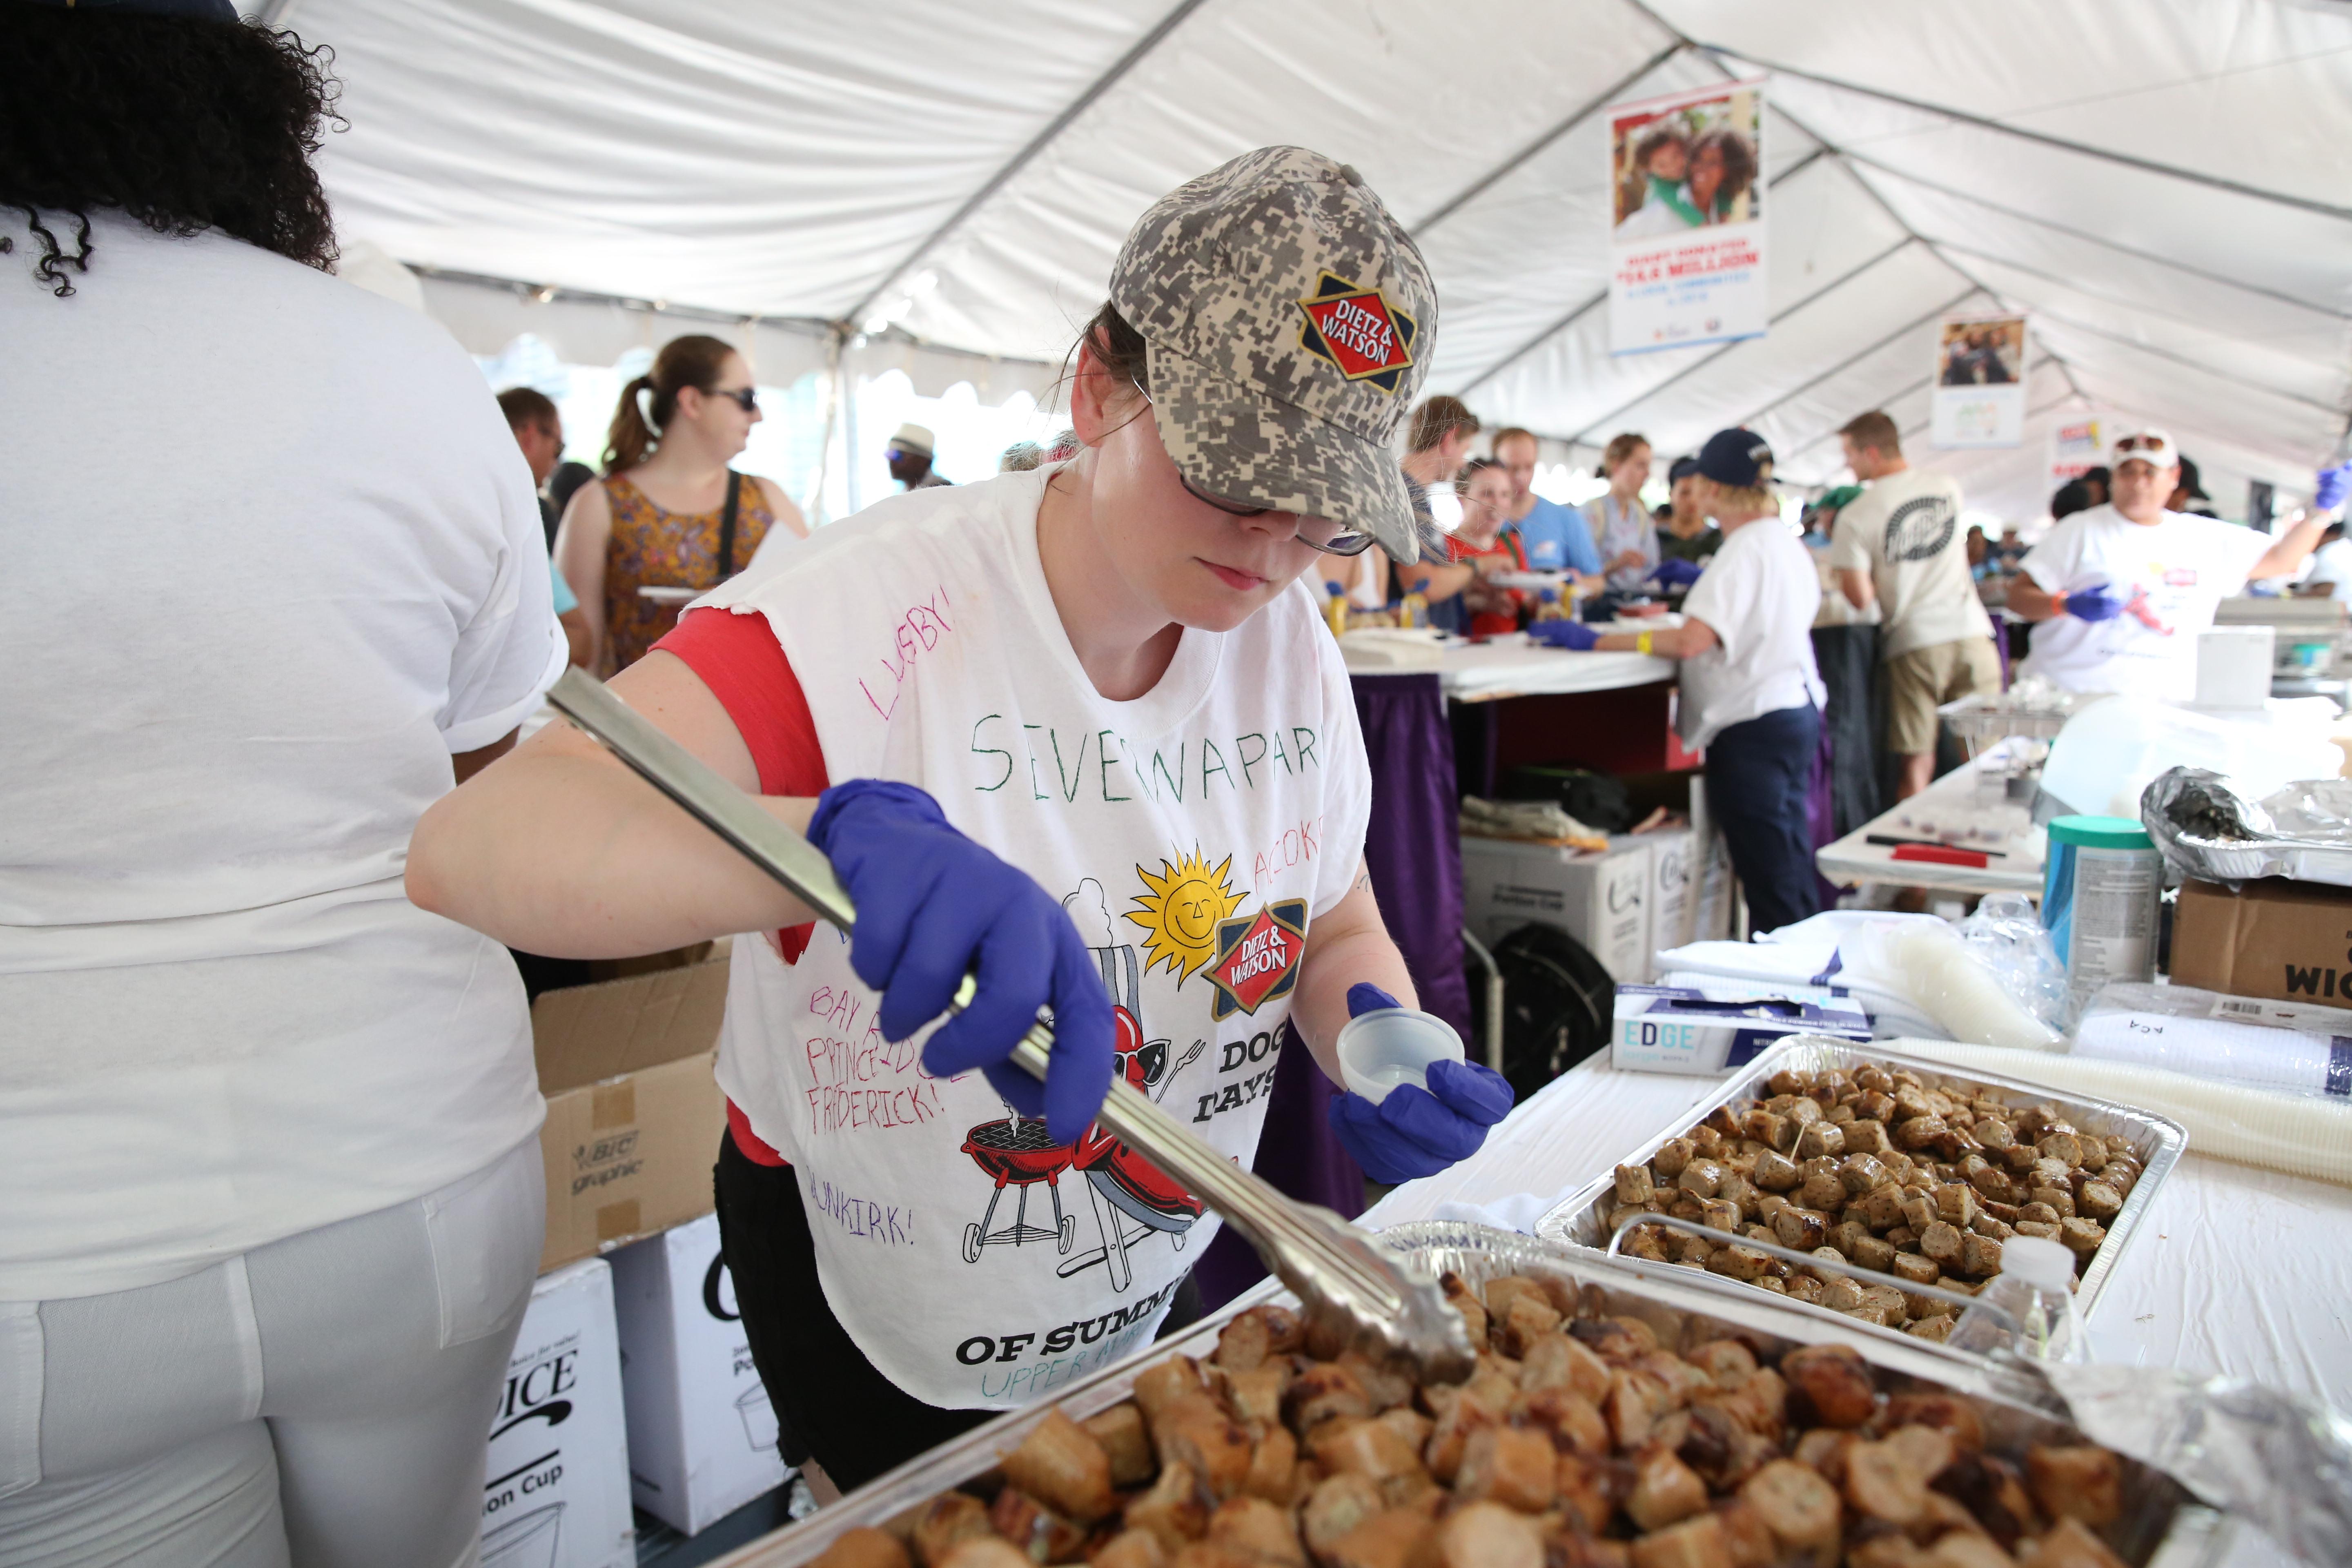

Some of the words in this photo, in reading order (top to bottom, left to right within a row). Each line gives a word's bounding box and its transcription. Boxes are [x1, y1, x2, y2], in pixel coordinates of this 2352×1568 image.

[1322, 314, 1390, 366] WATSON
[1335, 300, 1383, 339] DIETZ
[1380, 325, 1392, 347] &
[1241, 929, 1269, 962] DIETZ
[1270, 925, 1287, 947] &
[1231, 947, 1286, 987] WATSON
[810, 986, 861, 1032] BAY
[1624, 1021, 1695, 1049] EDGE
[806, 1038, 879, 1085] PRINCE
[956, 1333, 1036, 1365] OF
[496, 1348, 578, 1419] ICE
[982, 1351, 1087, 1400] UPPER
[521, 1464, 563, 1494] Cup
